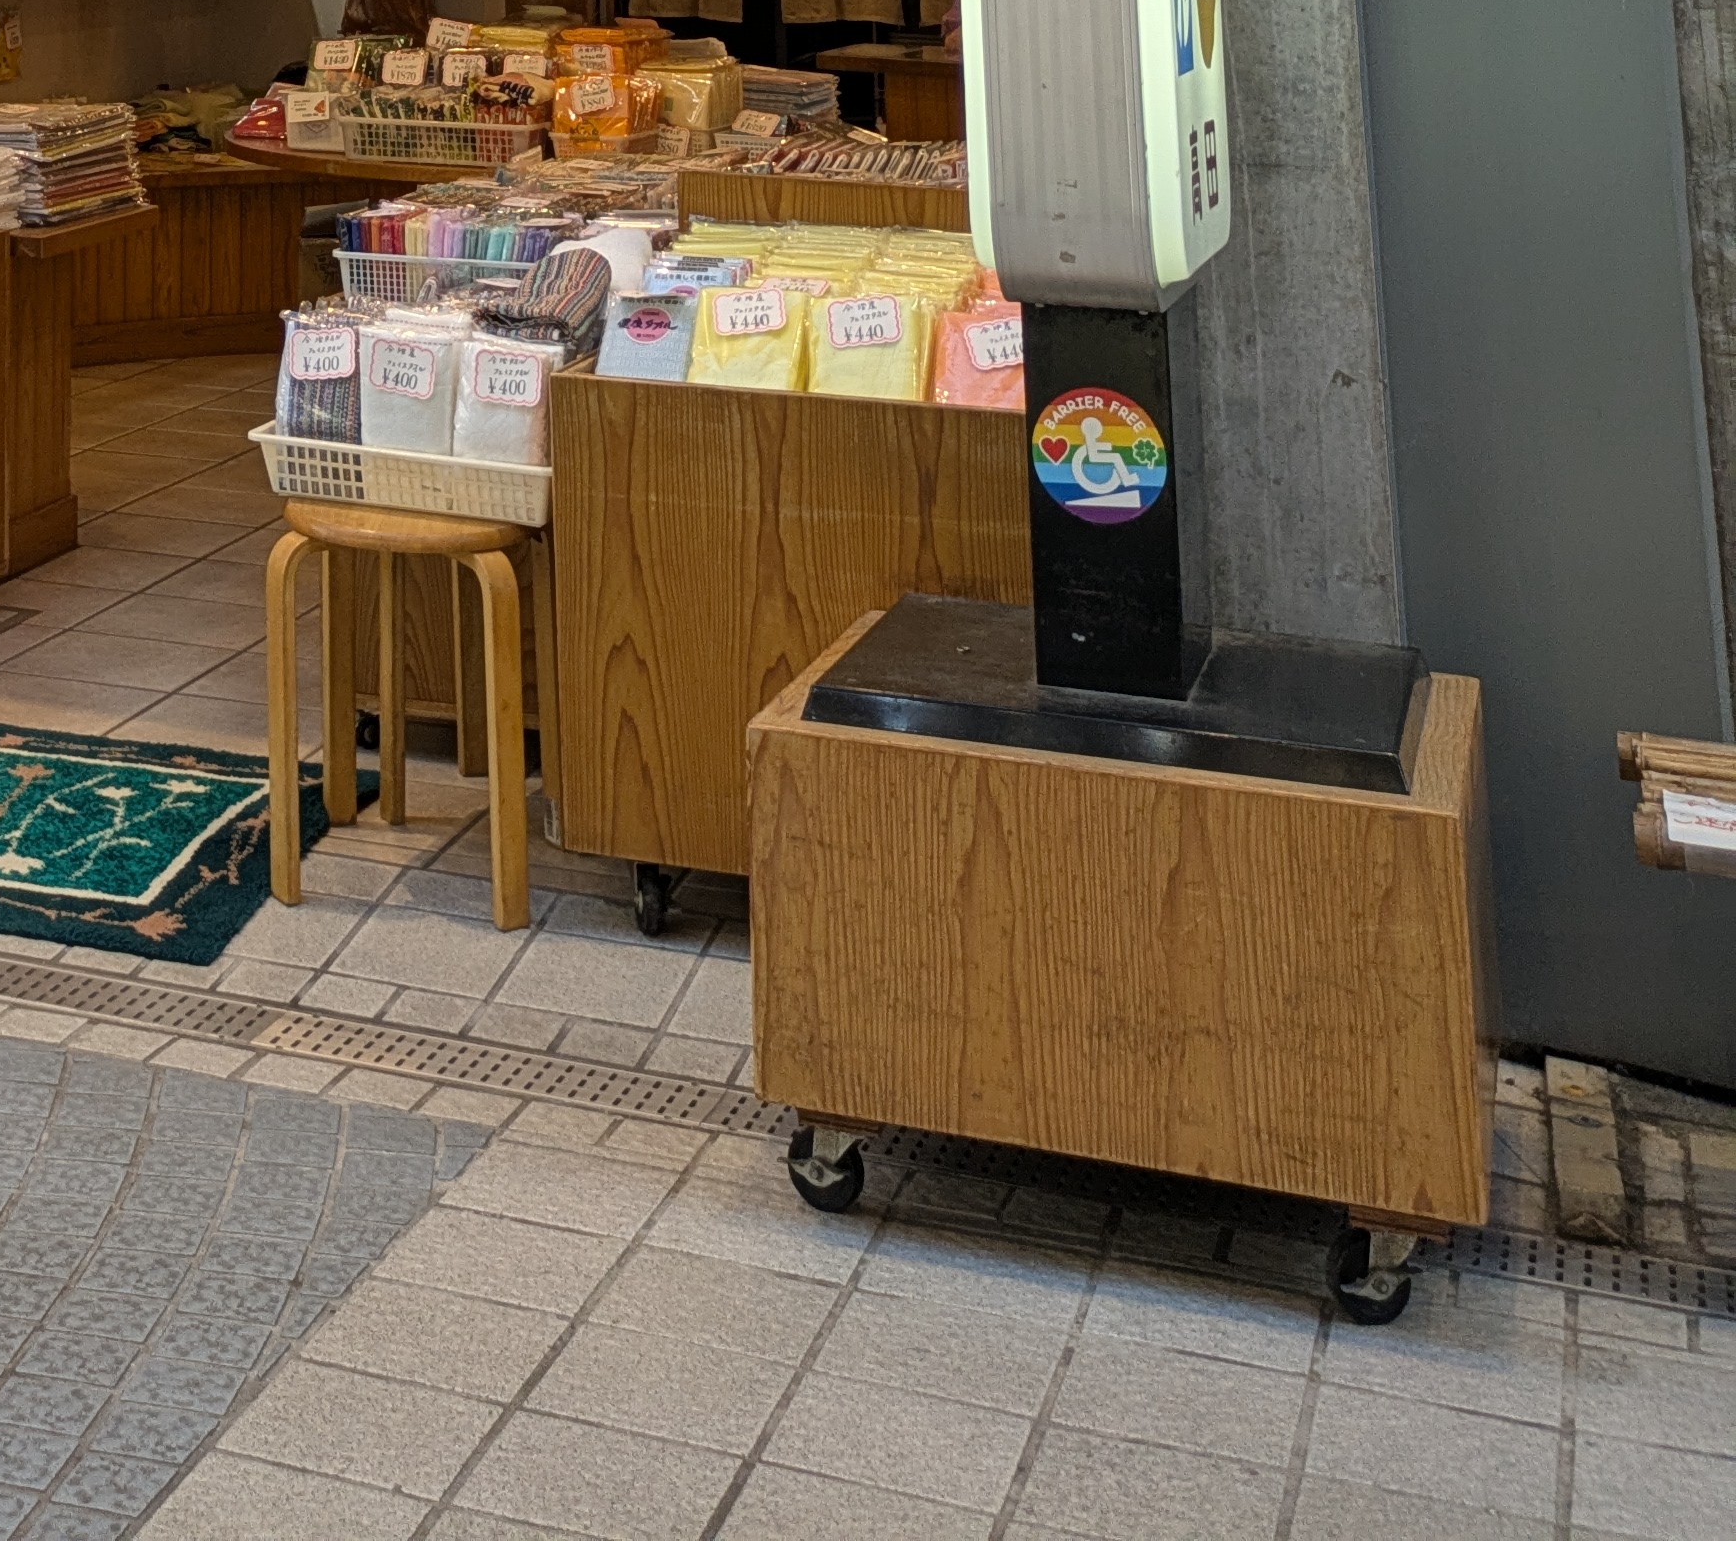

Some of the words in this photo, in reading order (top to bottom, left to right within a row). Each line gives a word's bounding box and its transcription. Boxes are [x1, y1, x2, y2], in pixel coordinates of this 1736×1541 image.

[729, 313, 771, 330] ¥440
[844, 323, 885, 342] ¥440
[302, 355, 341, 373] ¥400
[381, 367, 419, 391] ¥400
[487, 376, 527, 397] ¥400
[1043, 395, 1104, 430] BARRIER
[1109, 400, 1147, 435] FREE
